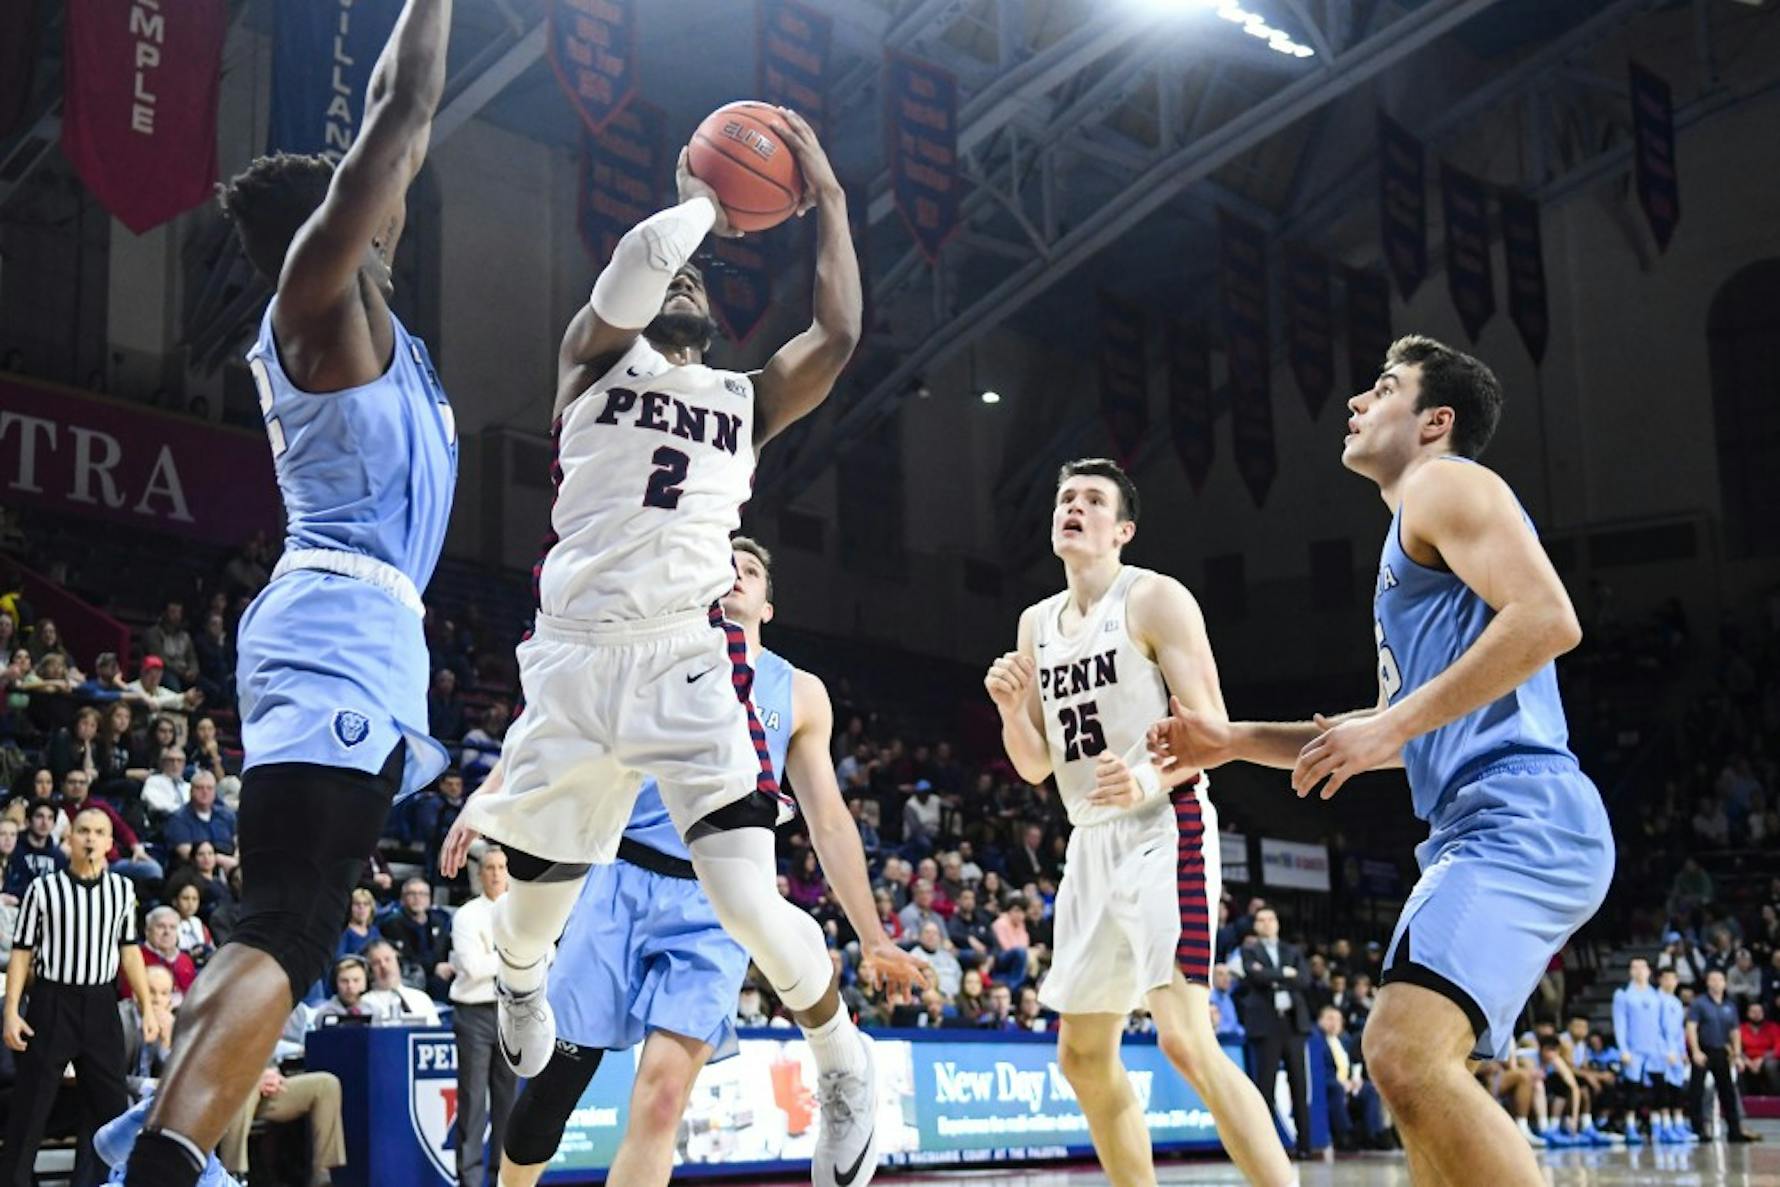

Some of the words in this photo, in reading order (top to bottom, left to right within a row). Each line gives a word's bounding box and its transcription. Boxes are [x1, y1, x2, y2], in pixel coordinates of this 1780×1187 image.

[594, 387, 742, 456] PENN
[642, 445, 690, 510] 2
[1040, 649, 1118, 701] PENN
[1058, 700, 1107, 763] 25
[934, 1062, 993, 1102] New
[995, 1061, 1046, 1112] Day
